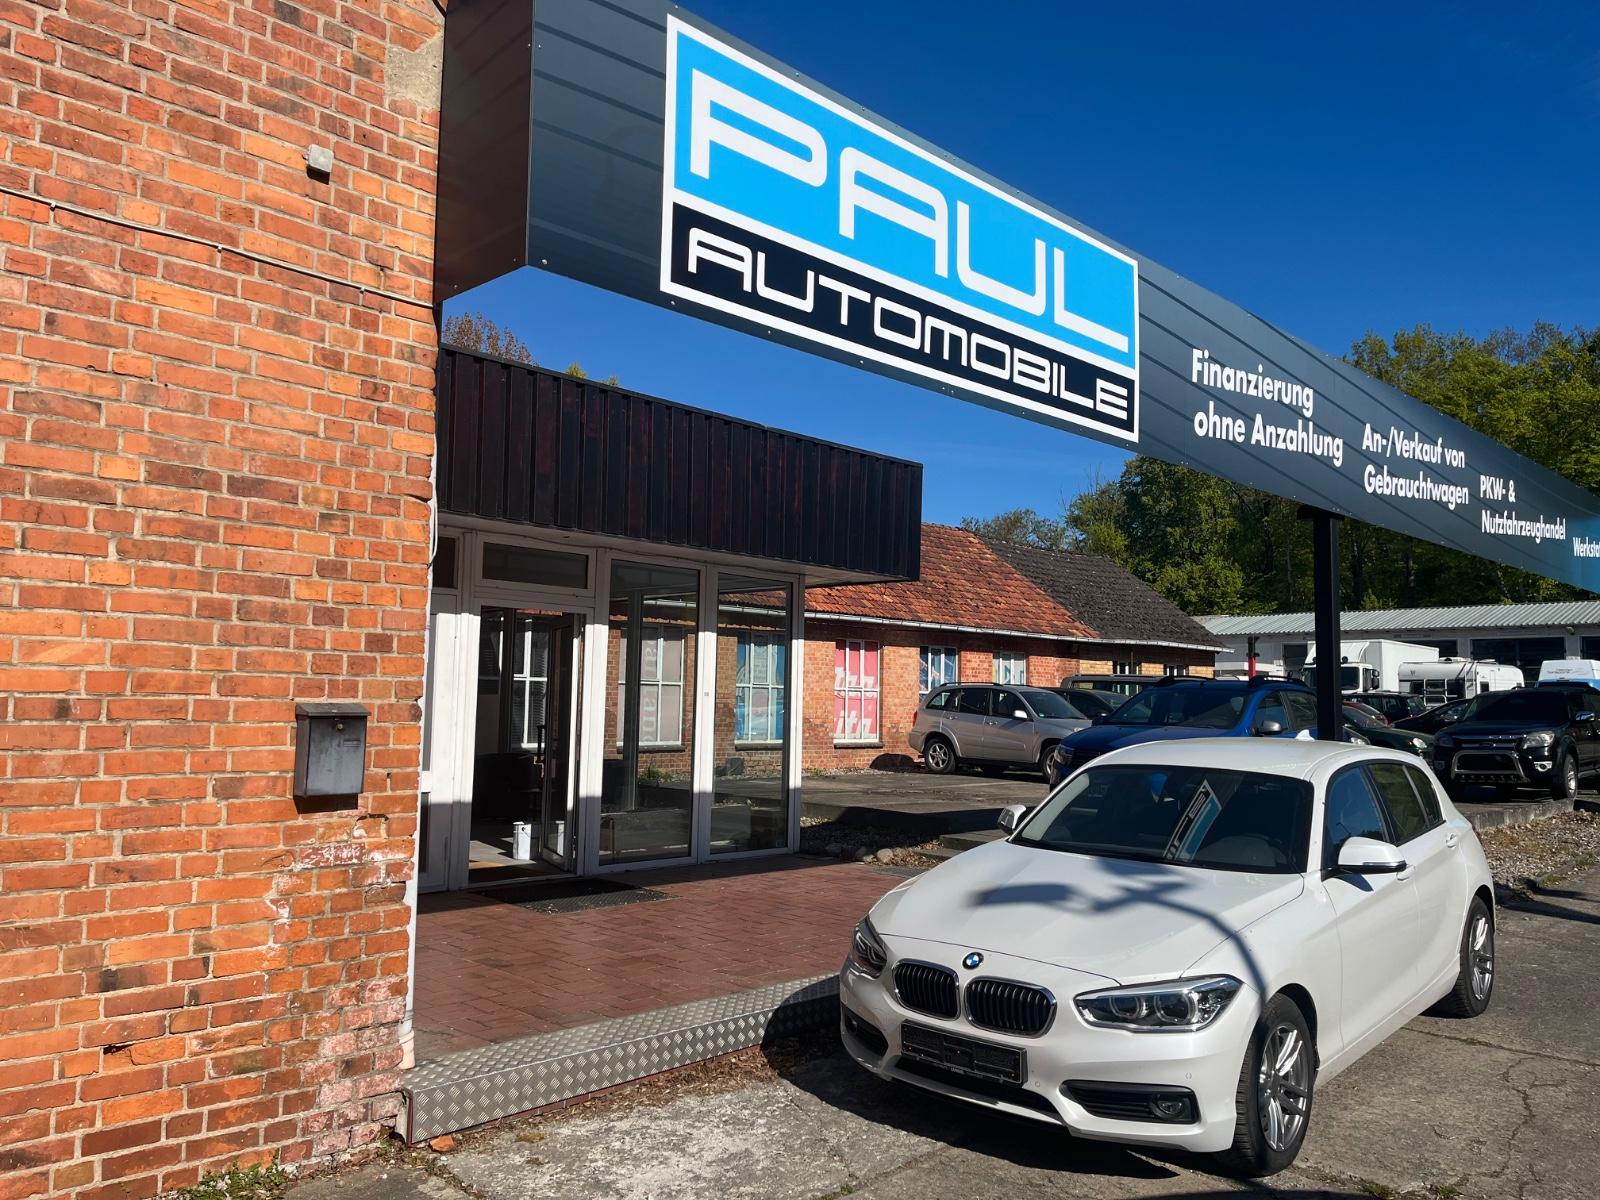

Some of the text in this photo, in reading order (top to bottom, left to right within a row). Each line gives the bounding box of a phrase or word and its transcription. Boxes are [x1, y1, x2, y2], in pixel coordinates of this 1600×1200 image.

[690, 68, 1129, 353] PAUL
[688, 227, 1128, 421] AUTOMOBILE
[1192, 349, 1314, 418] Finanzierung
[1193, 401, 1343, 468] ohne Anzahlung
[1362, 423, 1465, 469] An-/Verkauf von
[1364, 464, 1469, 511] Gebrauchtwagen
[1480, 475, 1516, 502] PKW- &
[1481, 509, 1566, 544] Nutzfahrzeughandel
[1573, 537, 1600, 558] Werksta
